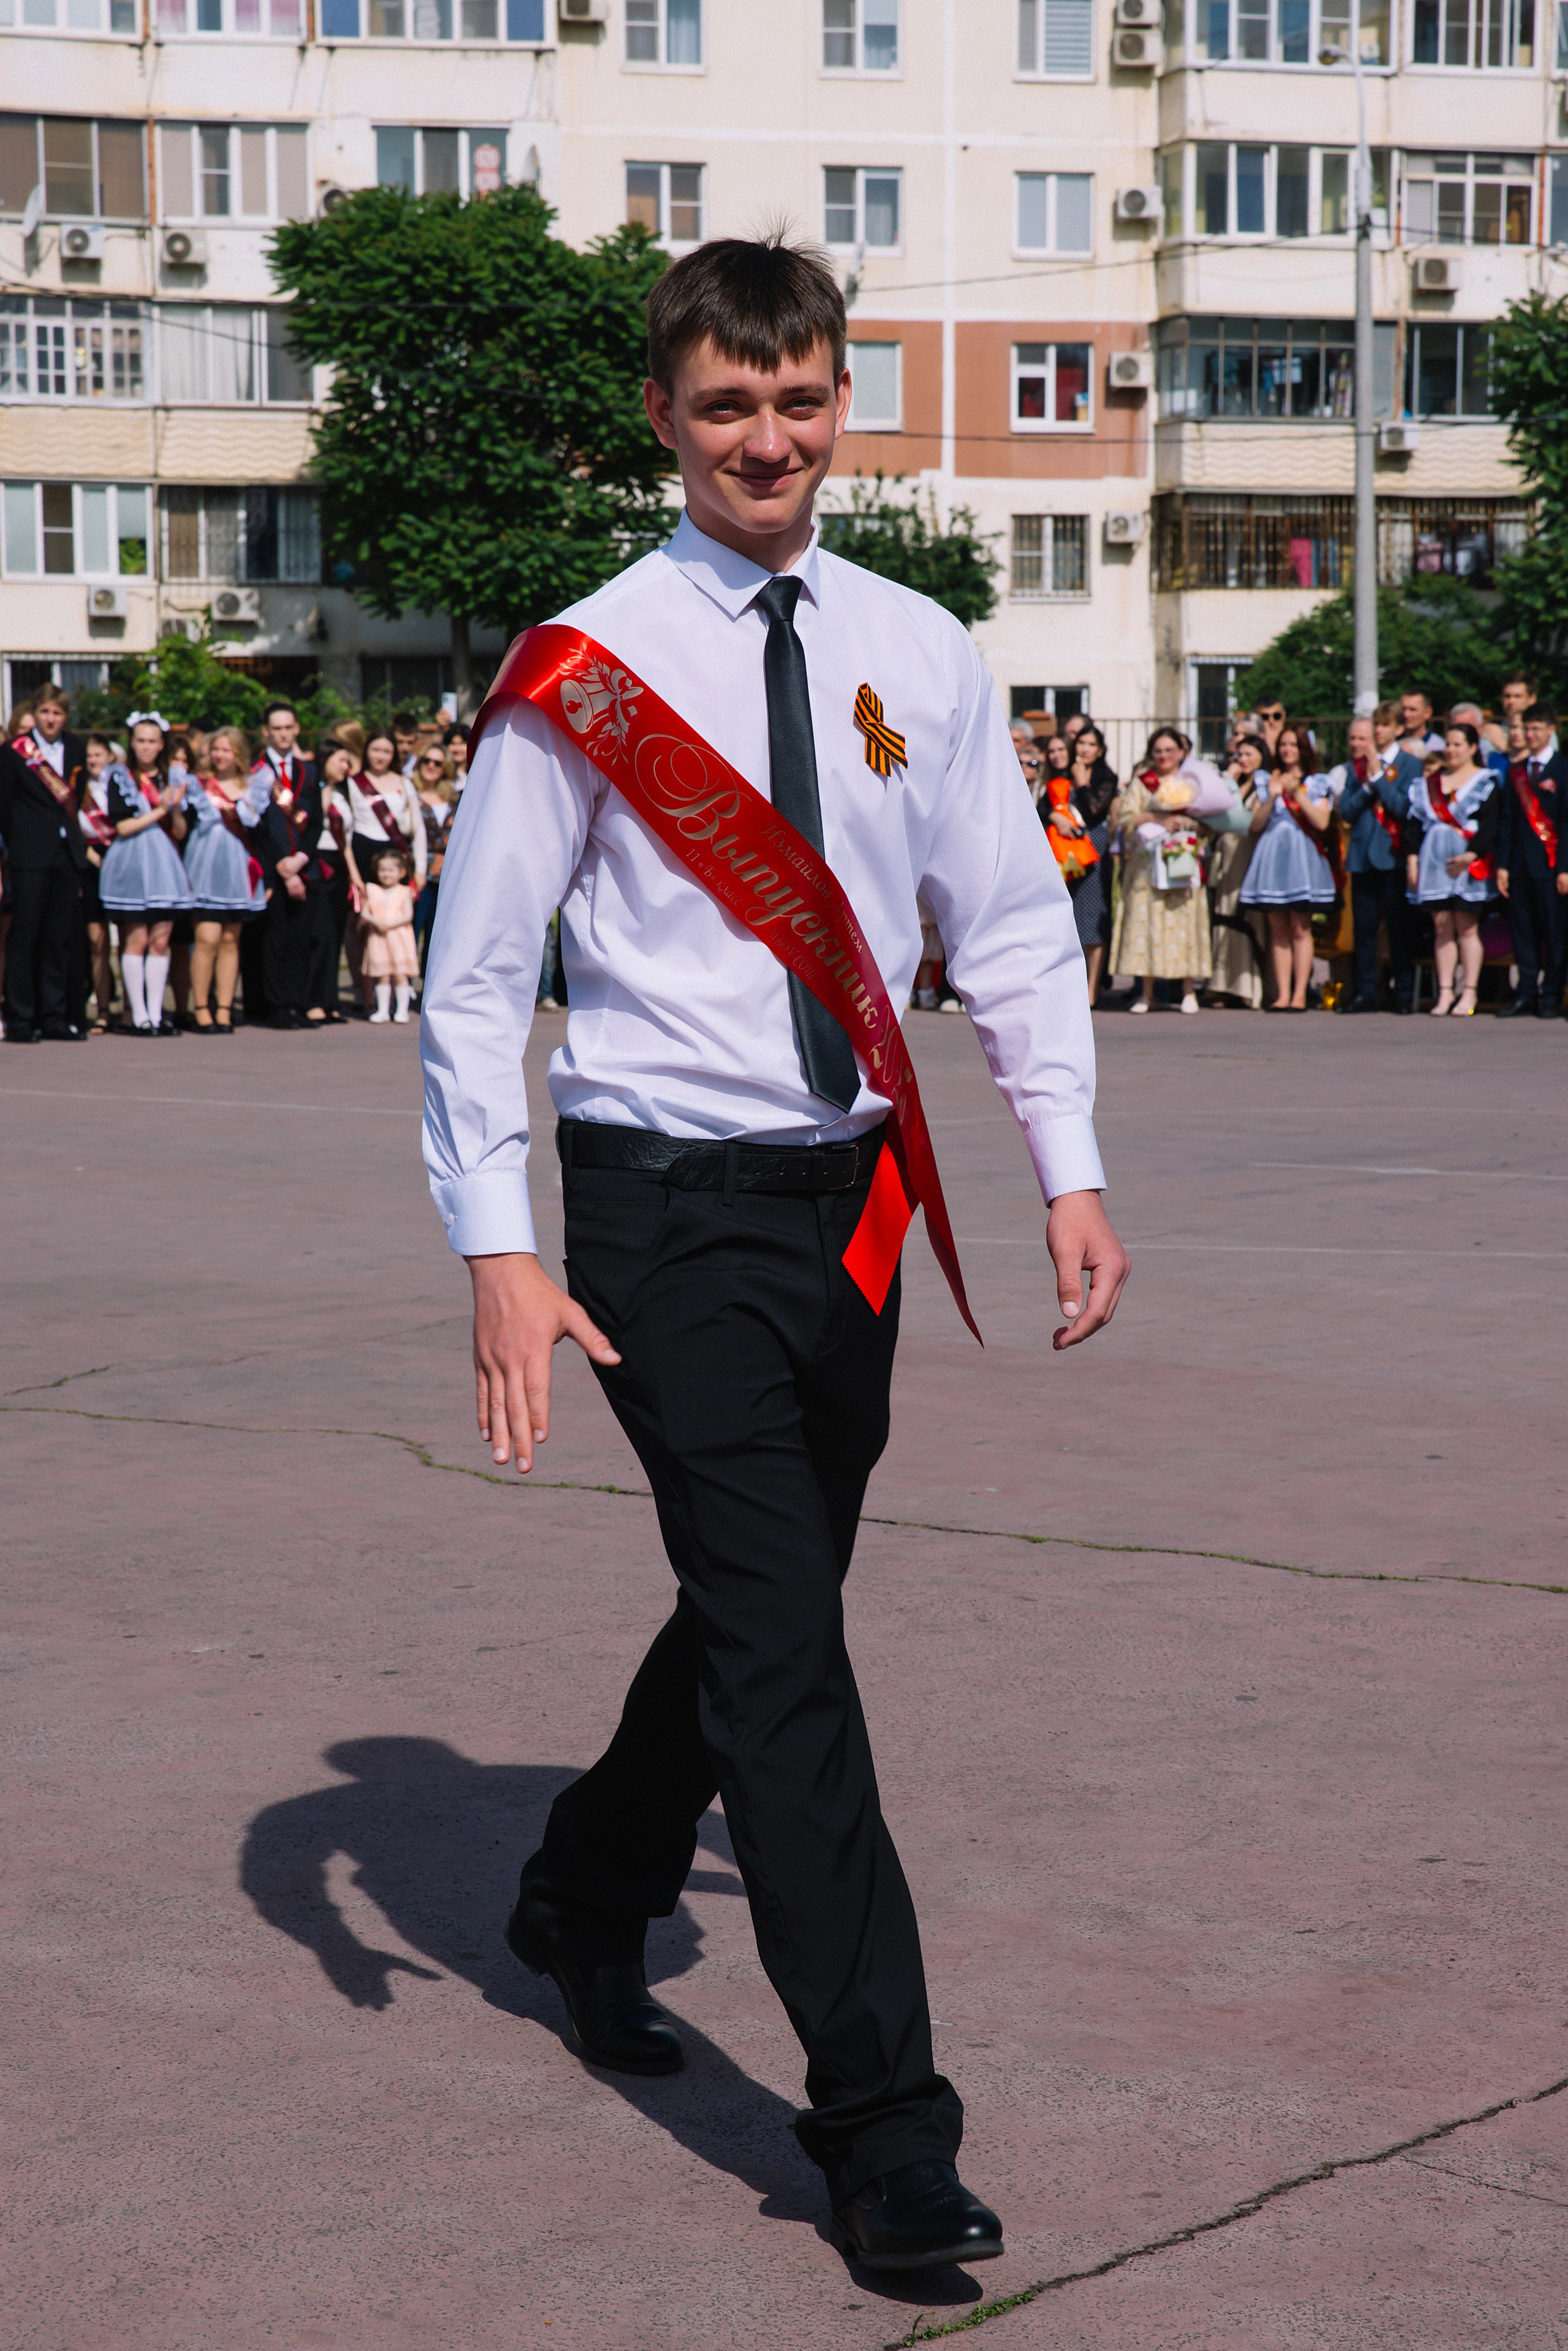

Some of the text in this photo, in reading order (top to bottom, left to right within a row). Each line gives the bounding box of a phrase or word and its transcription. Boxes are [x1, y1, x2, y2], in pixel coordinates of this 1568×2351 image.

[635, 733, 878, 1029] Выпускник
[686, 848, 701, 862] 11
[716, 880, 742, 906] класс
[758, 823, 831, 899] Измайлов
